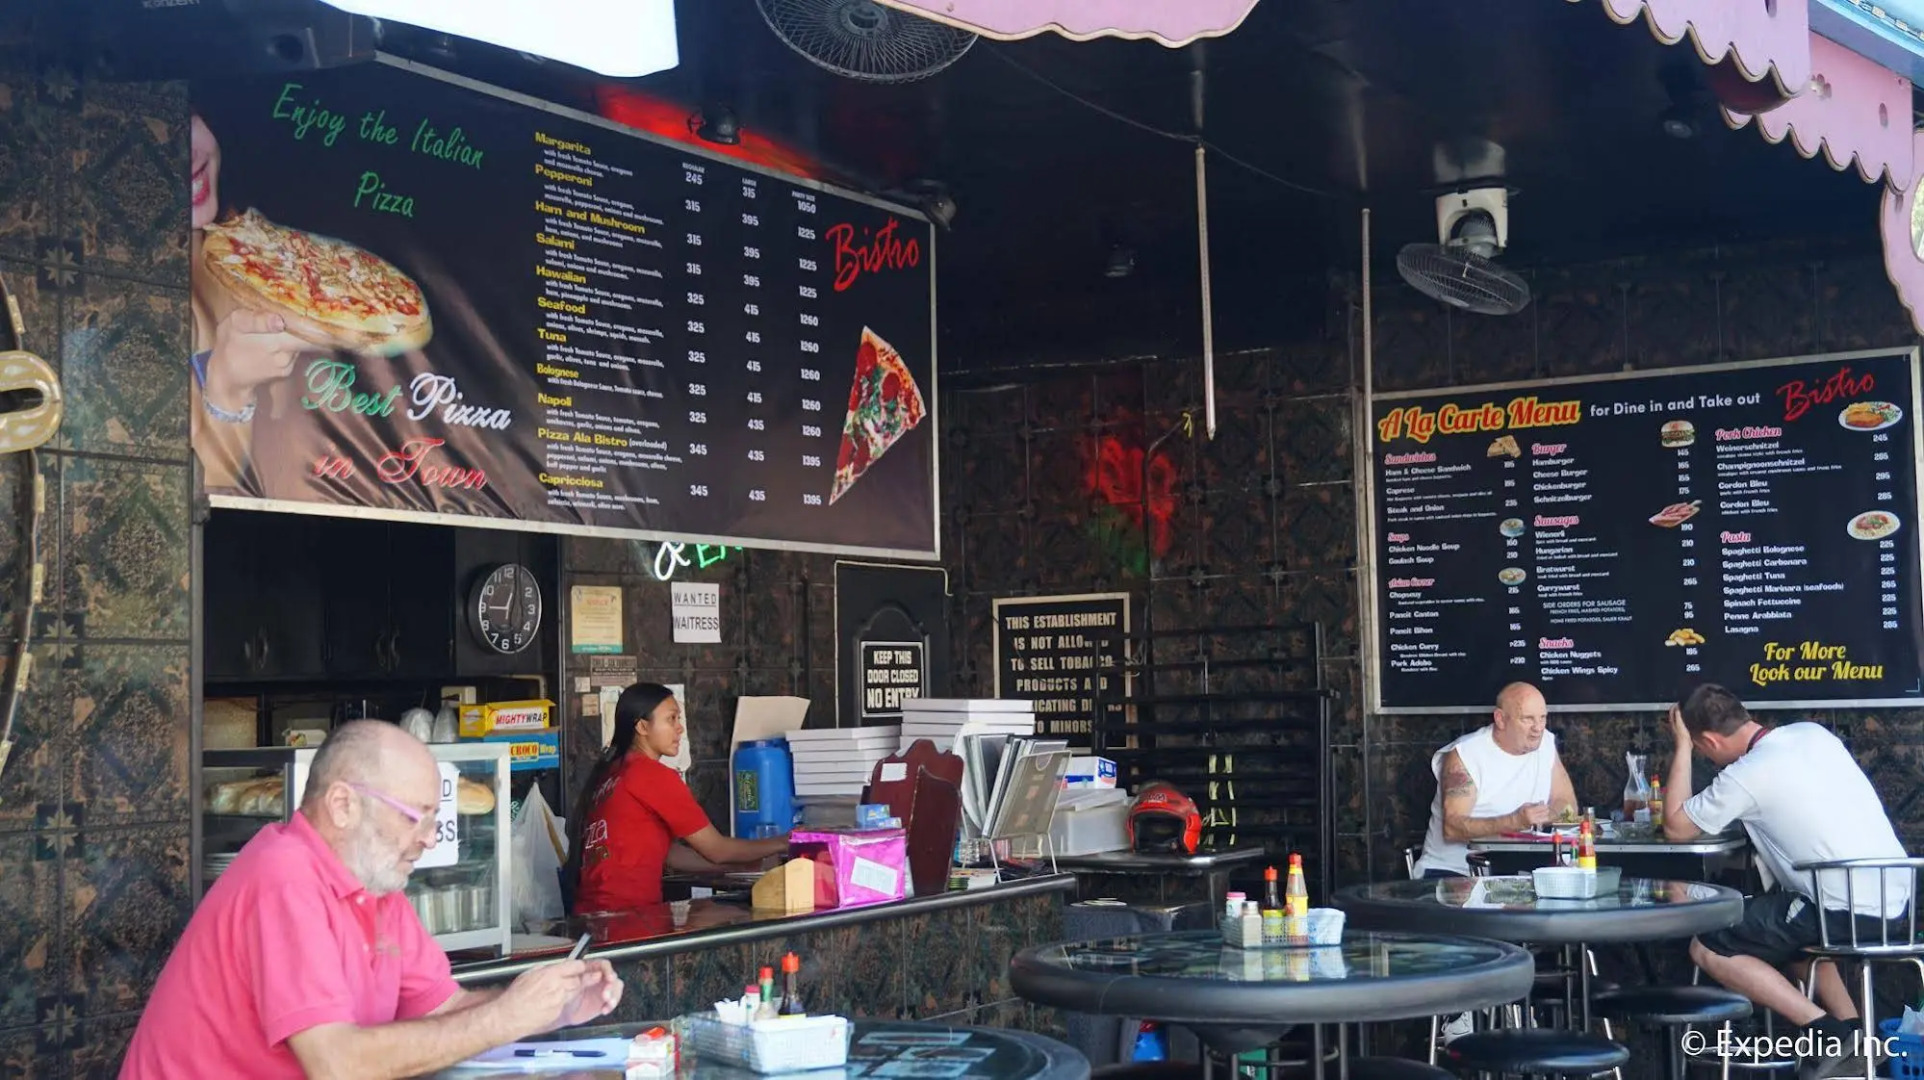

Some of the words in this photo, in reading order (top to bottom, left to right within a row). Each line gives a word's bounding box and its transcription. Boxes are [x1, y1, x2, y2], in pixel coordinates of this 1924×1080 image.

[273, 82, 345, 146] Enjoy
[360, 110, 398, 144] the
[411, 119, 485, 170] Italian
[535, 132, 591, 155] Margarita
[535, 163, 592, 187] Pepperoni
[685, 172, 702, 185] 245
[354, 171, 414, 217] Pizza
[742, 186, 756, 199] 315
[685, 200, 700, 212] 315
[797, 200, 816, 214] 1050
[535, 201, 562, 216] Ham
[566, 209, 586, 221] and
[590, 213, 645, 234] Mushroom
[742, 213, 759, 226] 395
[687, 233, 702, 246] 315
[798, 226, 816, 240] 1225
[536, 233, 575, 250] Salami
[744, 246, 760, 259] 395
[825, 216, 919, 291] Bistro
[687, 263, 701, 275] 315
[799, 258, 817, 272] 1225
[744, 274, 760, 287] 395
[687, 292, 704, 305] 325
[799, 286, 817, 299] 1225
[538, 297, 585, 314] Seafood
[744, 303, 759, 316] 415
[687, 321, 705, 333] 325
[800, 314, 819, 327] 1260
[537, 328, 566, 343] Tuna
[746, 330, 761, 344] 415
[800, 340, 819, 353] 1260
[688, 351, 705, 363] 325
[536, 363, 579, 379] Bolognese
[746, 360, 761, 373] 415
[801, 368, 820, 381] 1260
[302, 358, 402, 417] Best
[406, 372, 511, 430] Pizza
[688, 383, 706, 396] 325
[1776, 364, 1874, 421] Bistro
[538, 392, 572, 407] Napoli
[747, 391, 762, 404] 415
[802, 399, 821, 411] 1260
[1590, 404, 1609, 417] for
[1614, 402, 1645, 415] Dine
[1650, 400, 1663, 412] in
[1667, 397, 1694, 410] and
[1699, 395, 1732, 407] Take
[1737, 393, 1760, 405] out
[689, 411, 706, 424] 325
[1378, 407, 1403, 442] A
[1404, 406, 1436, 444] La
[1437, 403, 1504, 435] Carte
[1508, 396, 1582, 429] Menu
[748, 419, 764, 431] 435
[802, 425, 821, 438] 1260
[538, 427, 570, 441] Pizza
[573, 431, 591, 443] Ala
[594, 434, 628, 448] Bistro
[1715, 429, 1741, 441] Pork
[1742, 426, 1782, 439] Chicken
[689, 443, 707, 456] 345
[748, 449, 764, 462] 435
[311, 443, 354, 480] in
[377, 437, 490, 490] Town
[802, 454, 821, 467] 1395
[1532, 458, 1574, 466] Hamburger
[539, 473, 603, 488] Capricciosa
[1718, 481, 1747, 490] Cordon
[690, 485, 708, 497] 345
[749, 489, 765, 502] 435
[803, 494, 822, 506] 1395
[1752, 499, 1769, 507] Bleu
[1720, 531, 1751, 543] Pasta
[1722, 547, 1761, 556] Spaghetti
[1722, 560, 1761, 568] Spaghetti
[1764, 558, 1807, 567] Carbonara
[494, 572, 501, 582] 11
[504, 568, 514, 578] 12
[1723, 572, 1762, 582] Spaghetti
[525, 587, 532, 598] 2
[1723, 585, 1762, 595] Spaghetti
[1765, 585, 1801, 593] Marinara
[674, 593, 717, 604] WANTED
[1724, 599, 1756, 608] Spinach
[528, 604, 535, 614] 3
[1724, 612, 1750, 620] Penne
[1752, 611, 1791, 619] Arabbiata
[482, 620, 489, 631] 8
[523, 622, 530, 631] 4
[673, 617, 719, 630] WAITRESS
[1006, 616, 1029, 630] THIS
[1034, 612, 1116, 629] ESTABLISHMENT
[1725, 626, 1759, 634] Lasagna
[491, 633, 499, 643] 7
[502, 639, 509, 649] 6
[1014, 637, 1025, 650] IS
[1031, 636, 1052, 649] NOT
[1539, 637, 1574, 649] Snacks
[874, 650, 892, 664] KEEP
[894, 650, 912, 664] THIS
[1570, 651, 1601, 659] Nuggets
[1764, 642, 1795, 661] For
[1800, 641, 1846, 660] More
[1011, 659, 1024, 671] TO
[1031, 658, 1054, 670] SELL
[1541, 667, 1569, 675] Chicken
[1571, 667, 1595, 675] Wings
[1597, 666, 1618, 675] Spicy
[867, 670, 889, 683] DOOR
[891, 670, 918, 683] CLOSED
[1750, 663, 1790, 686] Look
[1794, 666, 1826, 680] our
[1831, 660, 1883, 680] Menu
[1016, 678, 1077, 692] PRODUCTS
[1084, 677, 1107, 690] AD
[867, 688, 882, 708] NO
[496, 713, 548, 724] MIGHTYWRAP
